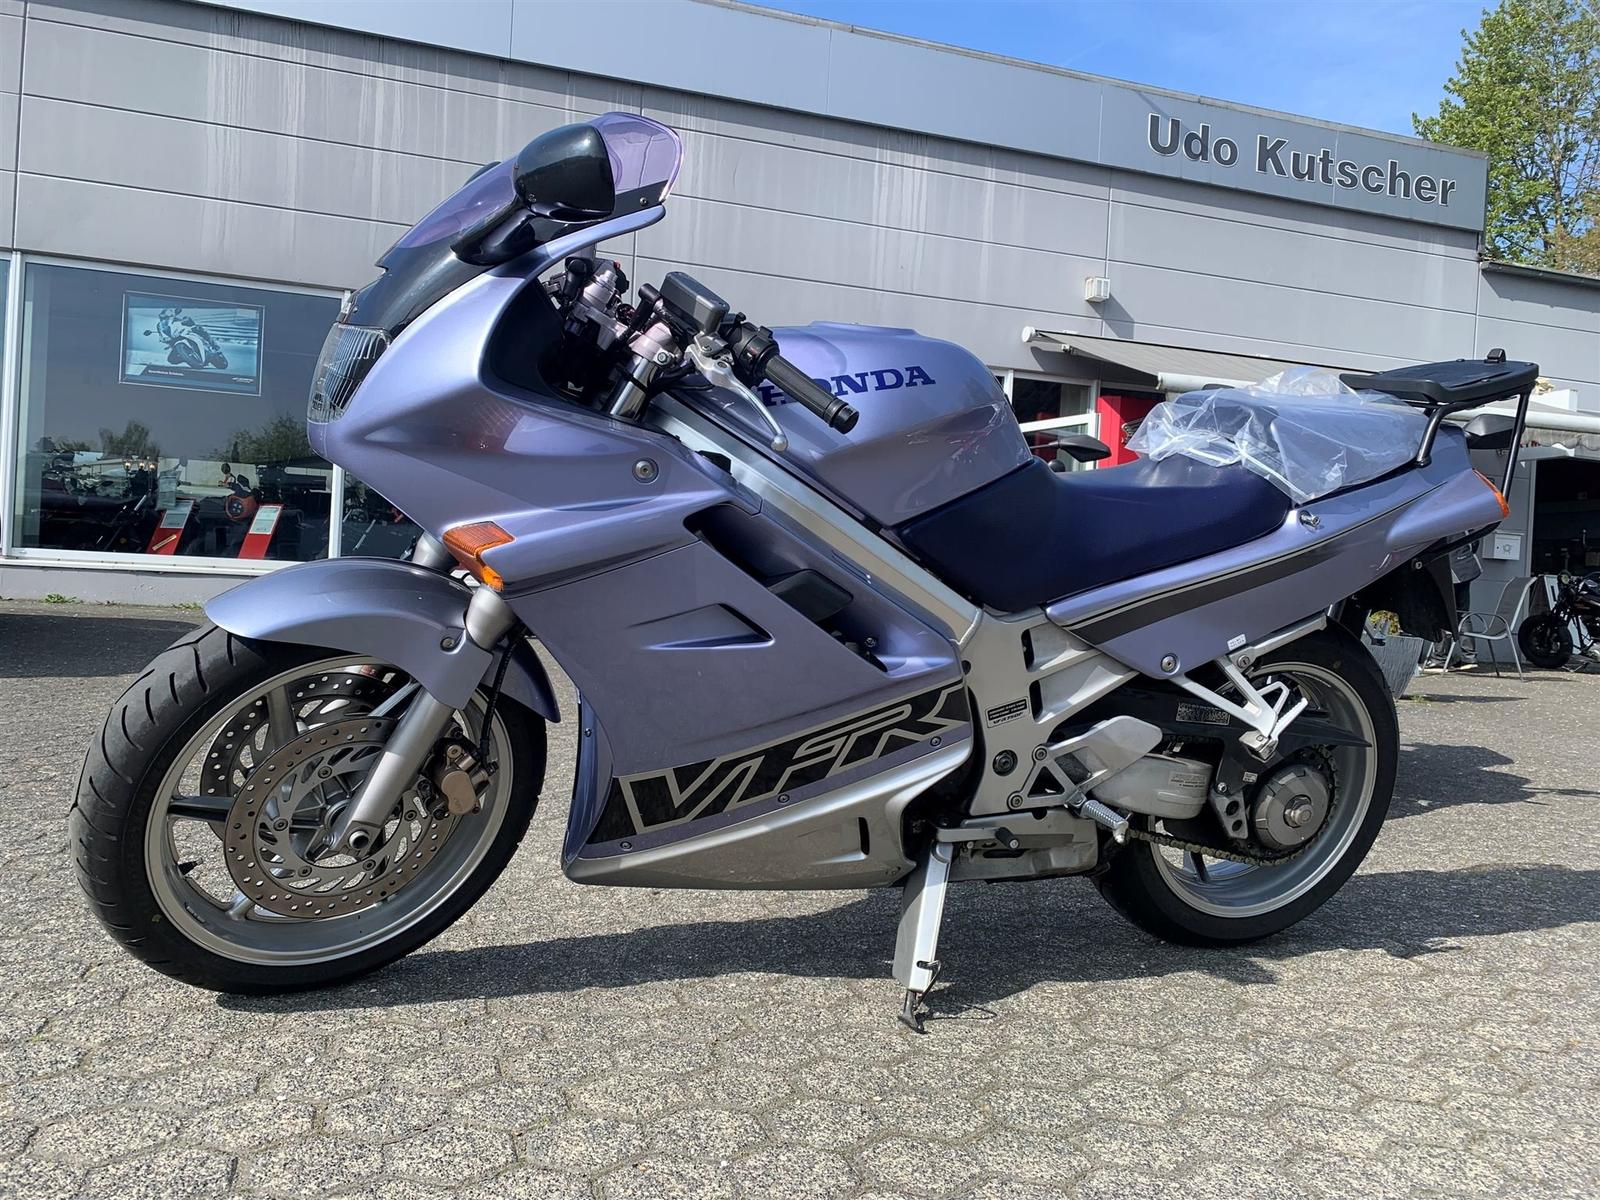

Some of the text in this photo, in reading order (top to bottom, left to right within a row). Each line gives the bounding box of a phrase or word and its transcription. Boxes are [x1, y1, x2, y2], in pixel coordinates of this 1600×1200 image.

[1148, 113, 1457, 207] Udo Kutscher
[618, 682, 971, 835] VFR
